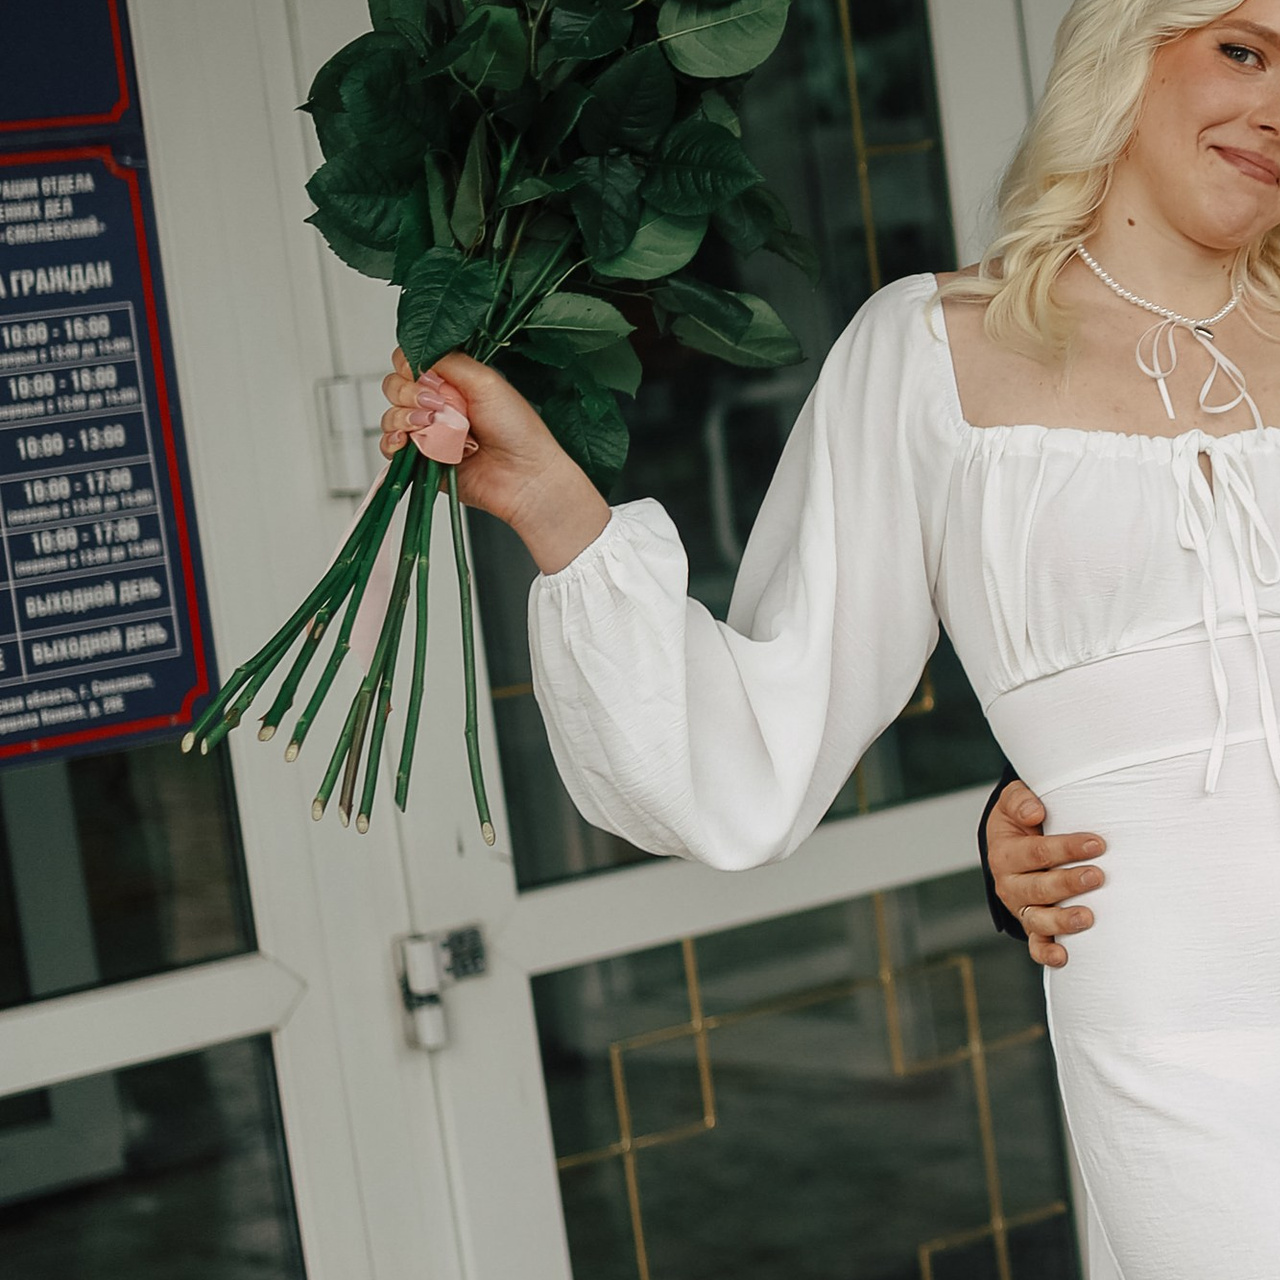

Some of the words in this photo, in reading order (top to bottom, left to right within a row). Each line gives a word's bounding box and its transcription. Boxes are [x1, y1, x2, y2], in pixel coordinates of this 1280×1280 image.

[44, 196, 73, 221] ДЕЛ
[10, 260, 113, 298] ГРАЖДАН
[1, 321, 48, 349] 10:00
[8, 372, 55, 401] 10:00
[16, 432, 64, 460] 10:00
[80, 424, 126, 452] 13:00
[24, 476, 71, 505] 10:00
[86, 467, 132, 495] 17:00
[31, 527, 78, 556] 10:00
[94, 517, 140, 545] 17:00
[25, 580, 117, 619] ВЫХОДНОЙ
[119, 576, 162, 606] ДЕНЬ
[31, 626, 123, 666] ВЫХОДНОЙ
[125, 621, 169, 653] ДЕНЬ
